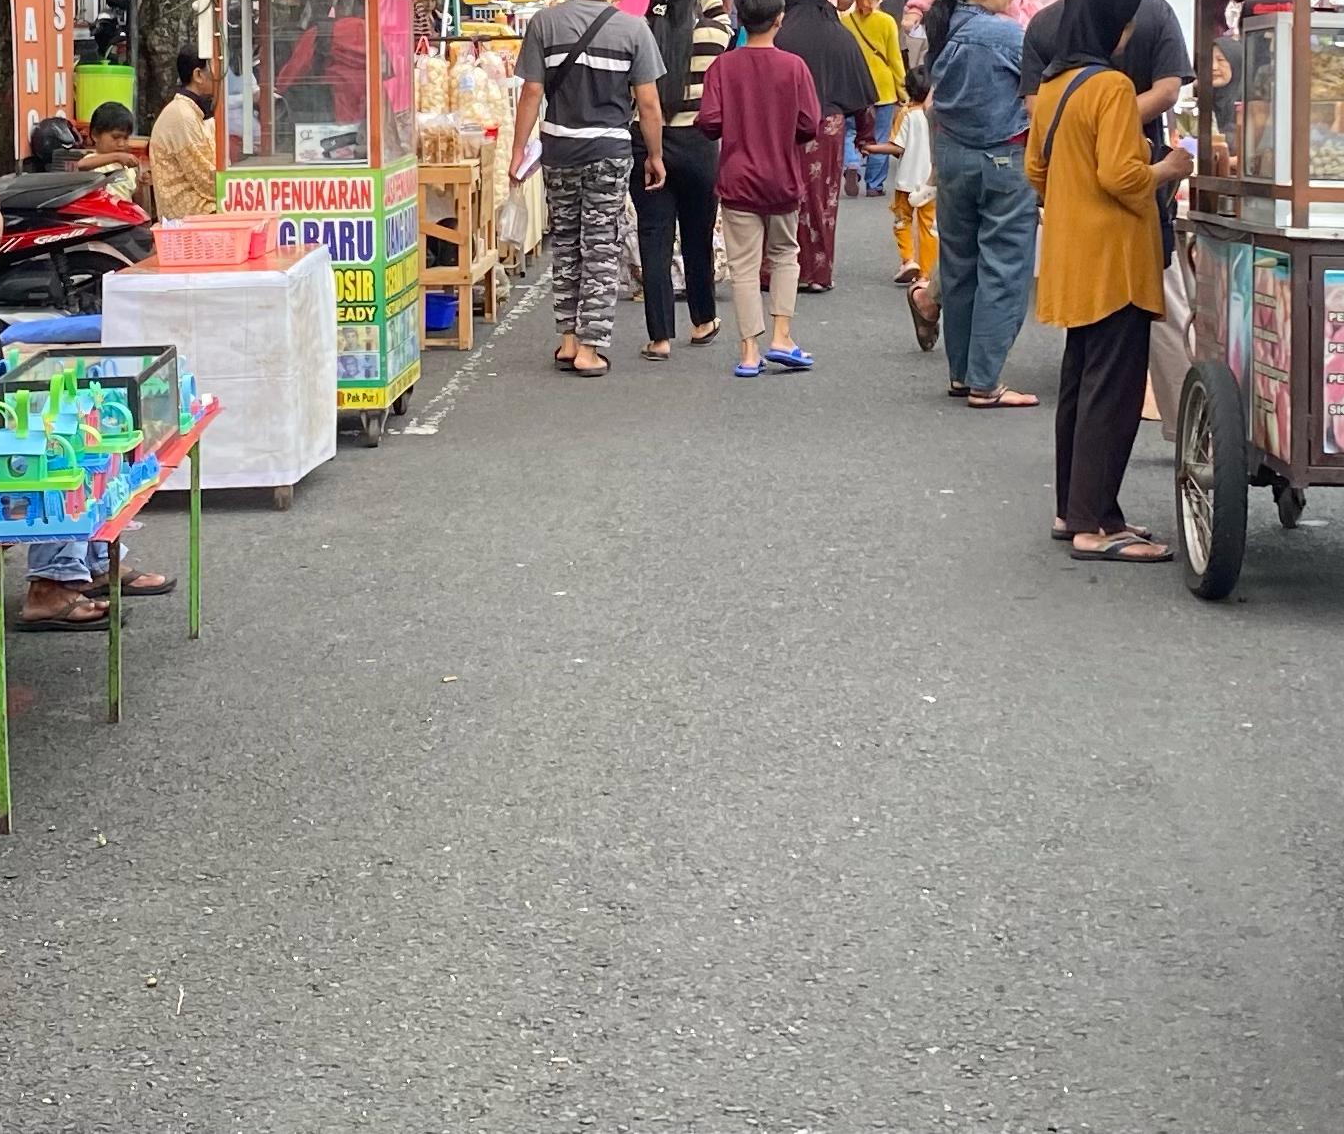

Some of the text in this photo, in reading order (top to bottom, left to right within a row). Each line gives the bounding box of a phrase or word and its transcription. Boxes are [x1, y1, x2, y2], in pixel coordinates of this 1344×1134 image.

[224, 181, 267, 212] JASA
[270, 179, 372, 211] PENUKARAN
[335, 269, 375, 303] OSIR
[337, 306, 377, 322] EADY
